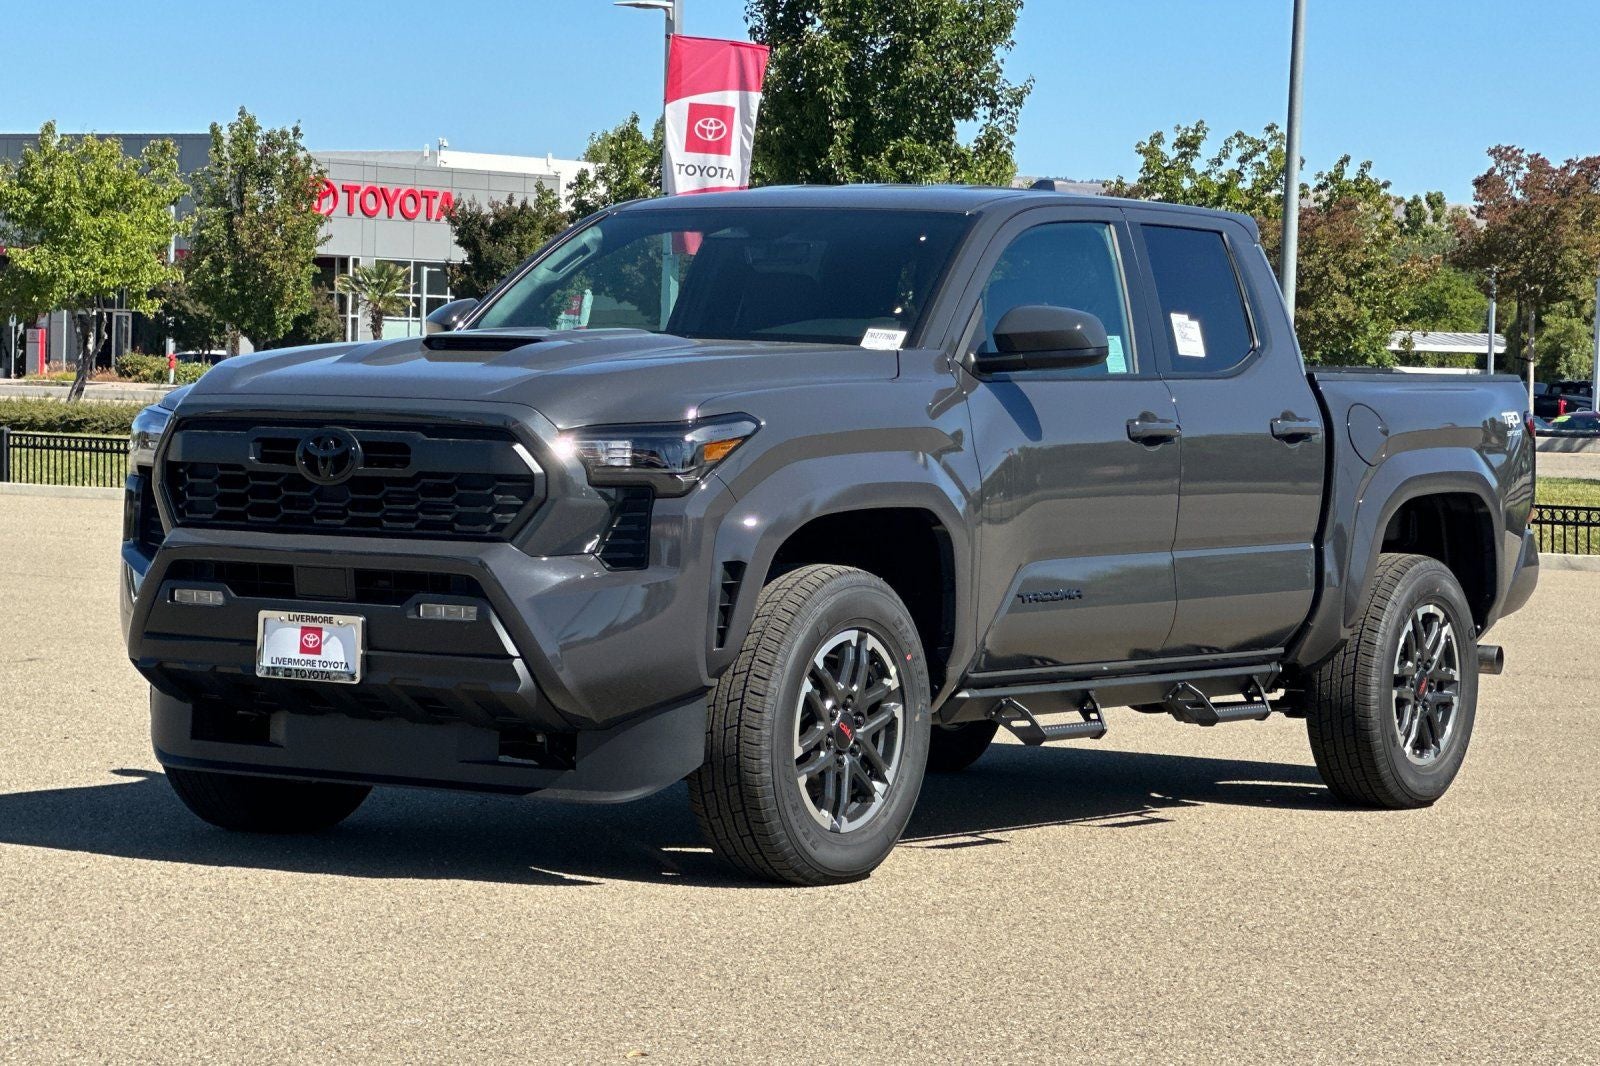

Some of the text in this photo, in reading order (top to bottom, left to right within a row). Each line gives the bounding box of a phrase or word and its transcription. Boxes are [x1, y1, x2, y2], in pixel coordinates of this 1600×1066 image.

[676, 163, 735, 181] TOYOTA
[342, 184, 454, 221] TOYOTA
[1501, 411, 1521, 428] TRD
[1016, 589, 1083, 604] TACOMA
[288, 614, 334, 624] LIVERMORE
[271, 656, 350, 670] LIVERMORE TOYOTA
[294, 668, 331, 680] TOYOTA
